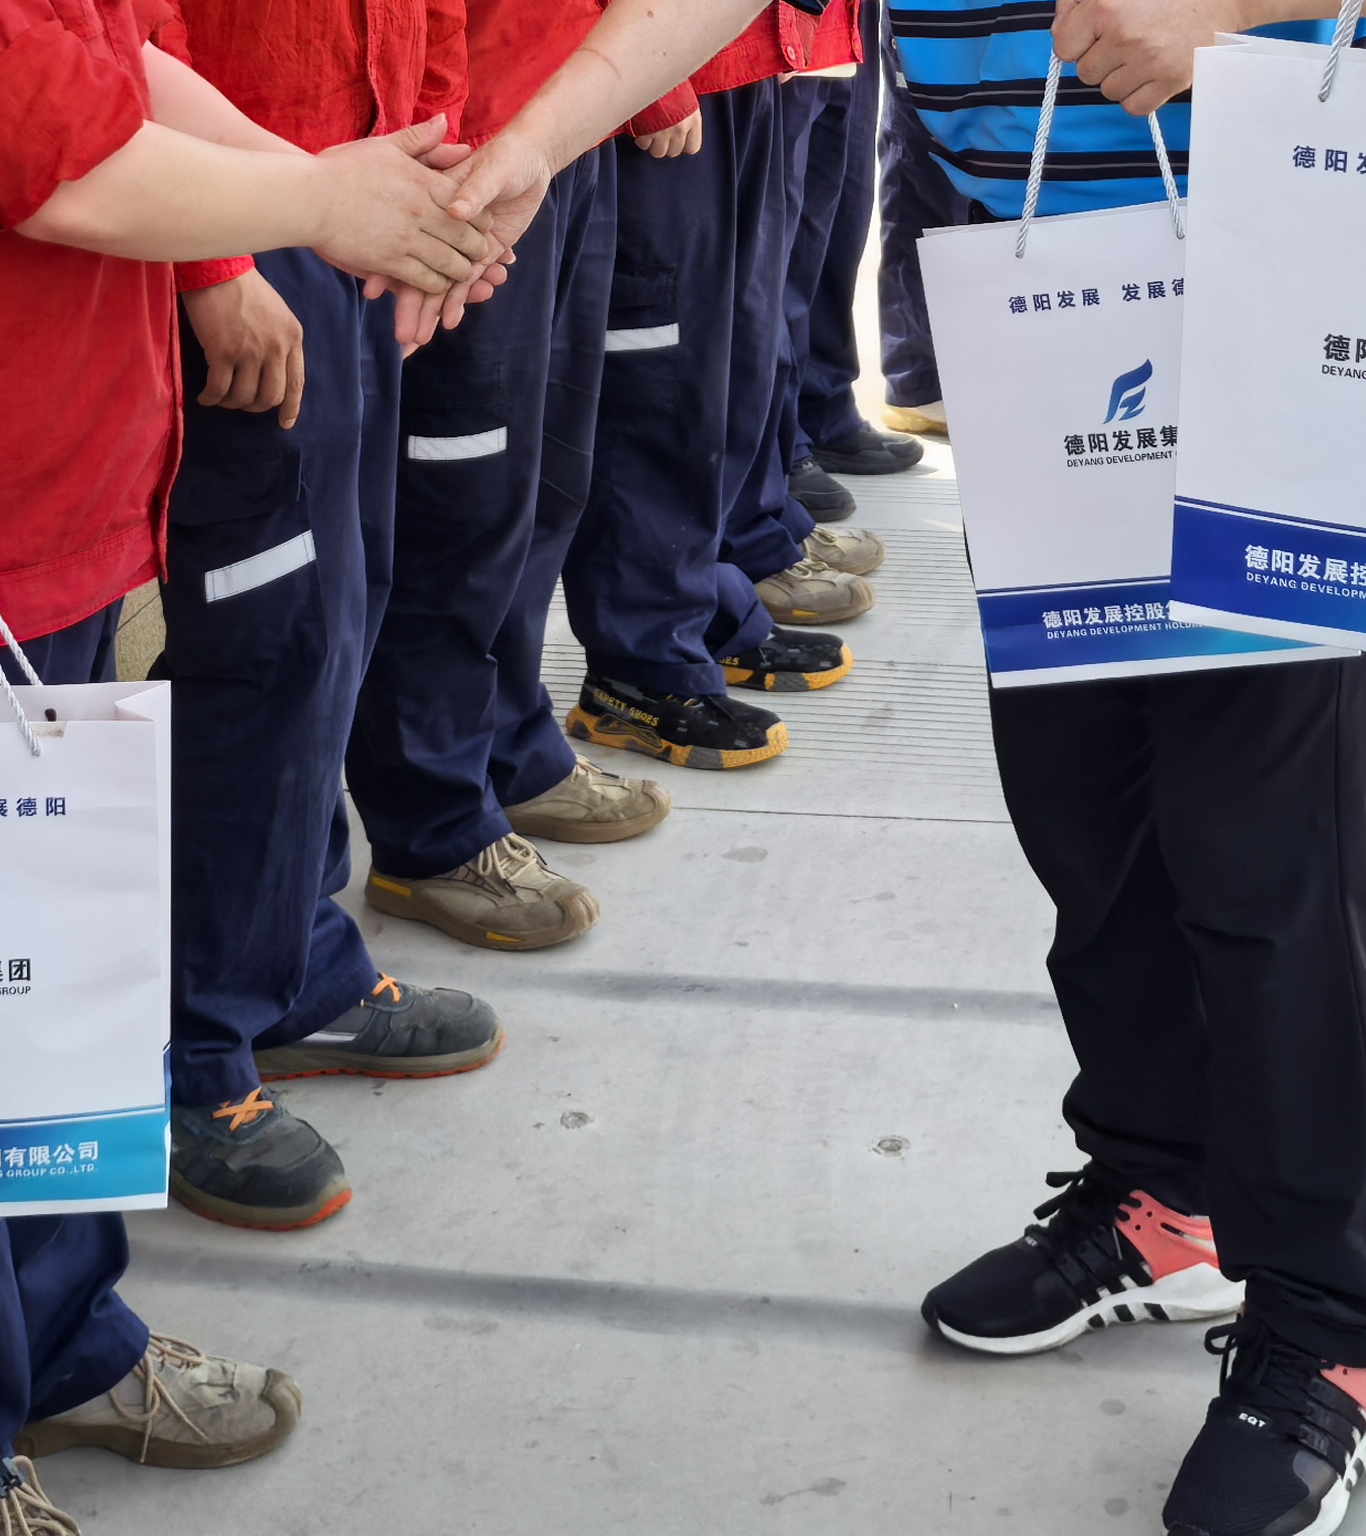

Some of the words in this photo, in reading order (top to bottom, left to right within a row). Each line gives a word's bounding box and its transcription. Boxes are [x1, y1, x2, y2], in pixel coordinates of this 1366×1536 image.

[1008, 288, 1101, 314] 德阳发展
[1064, 425, 1178, 456] 德阳发展集
[1066, 456, 1104, 468] DEYANG
[1106, 450, 1173, 465] DEVELOPMENT
[1246, 571, 1297, 589] DEYANG
[1041, 602, 1170, 629] 德阳发展控股
[1046, 628, 1088, 640] DEYANG
[1089, 622, 1162, 636] DEVELOPMENT
[5, 1167, 47, 1178] GROUP
[1238, 1412, 1266, 1428] EQT
